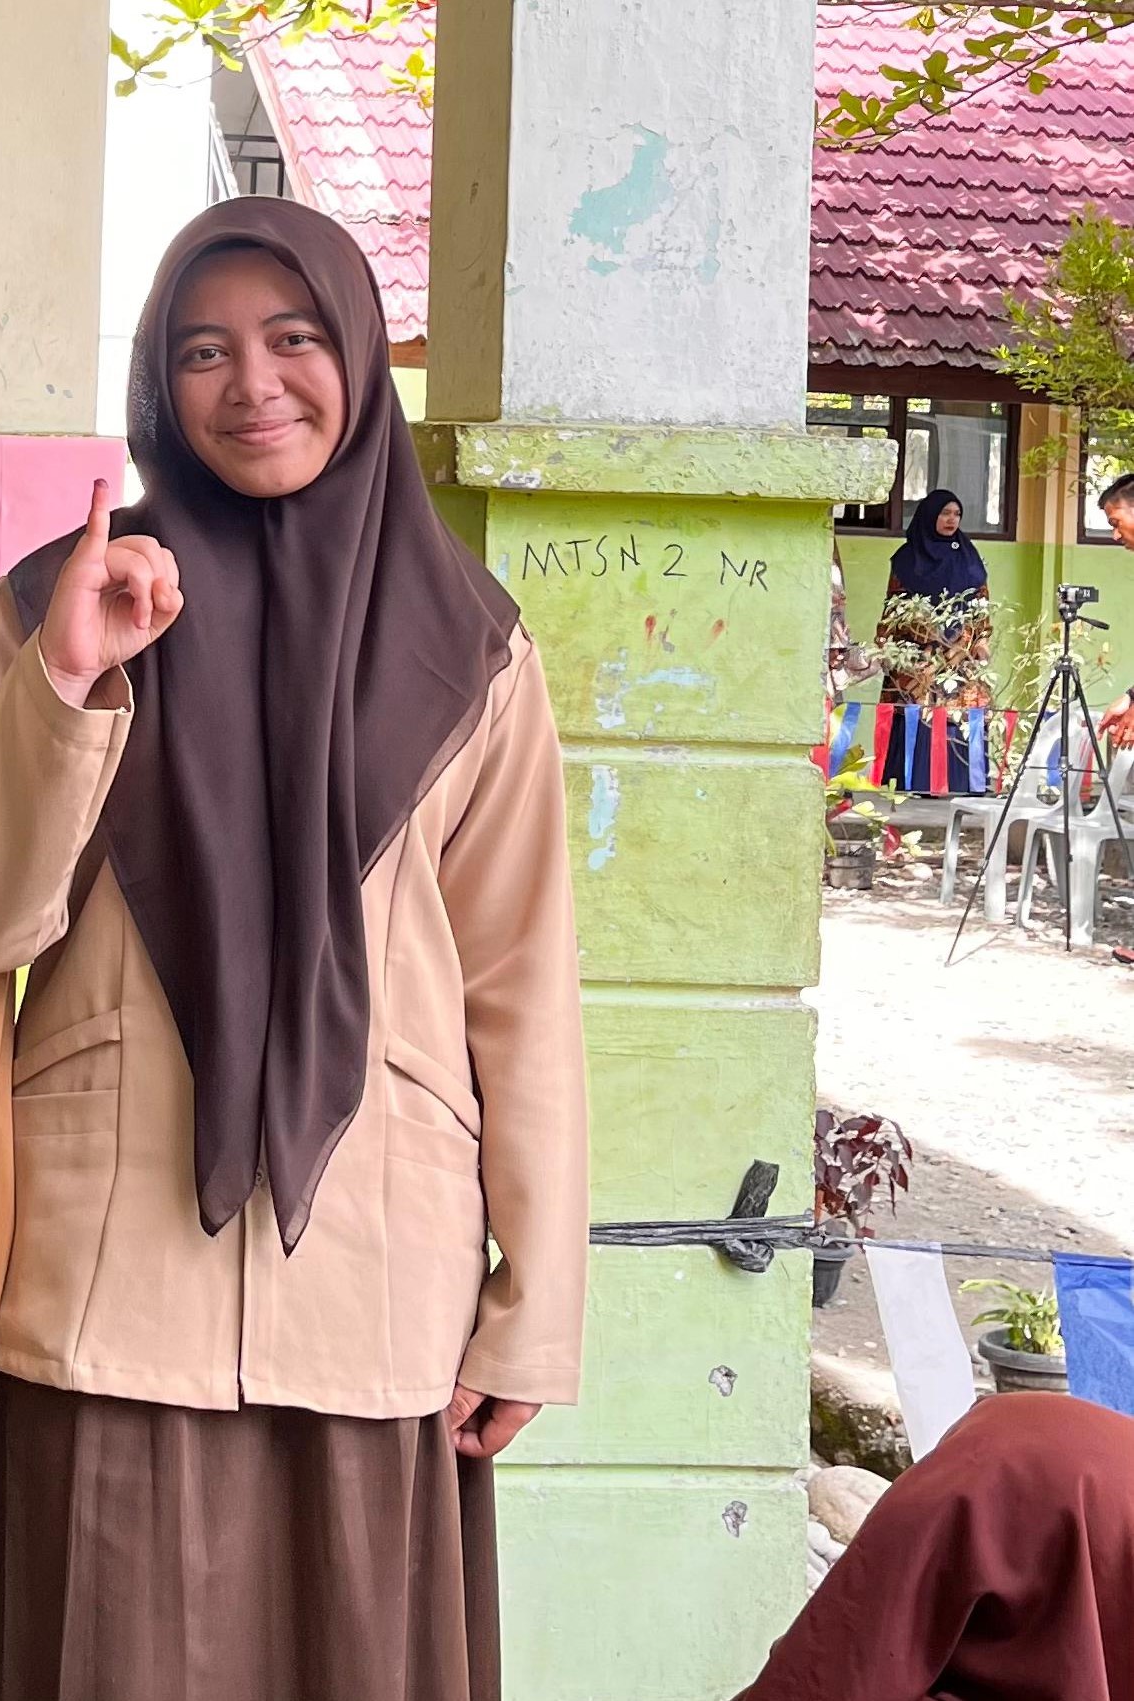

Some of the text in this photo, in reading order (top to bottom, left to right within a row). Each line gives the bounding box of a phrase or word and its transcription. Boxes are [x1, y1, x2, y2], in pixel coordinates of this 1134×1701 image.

[521, 534, 768, 592] MTSN 2 NR
